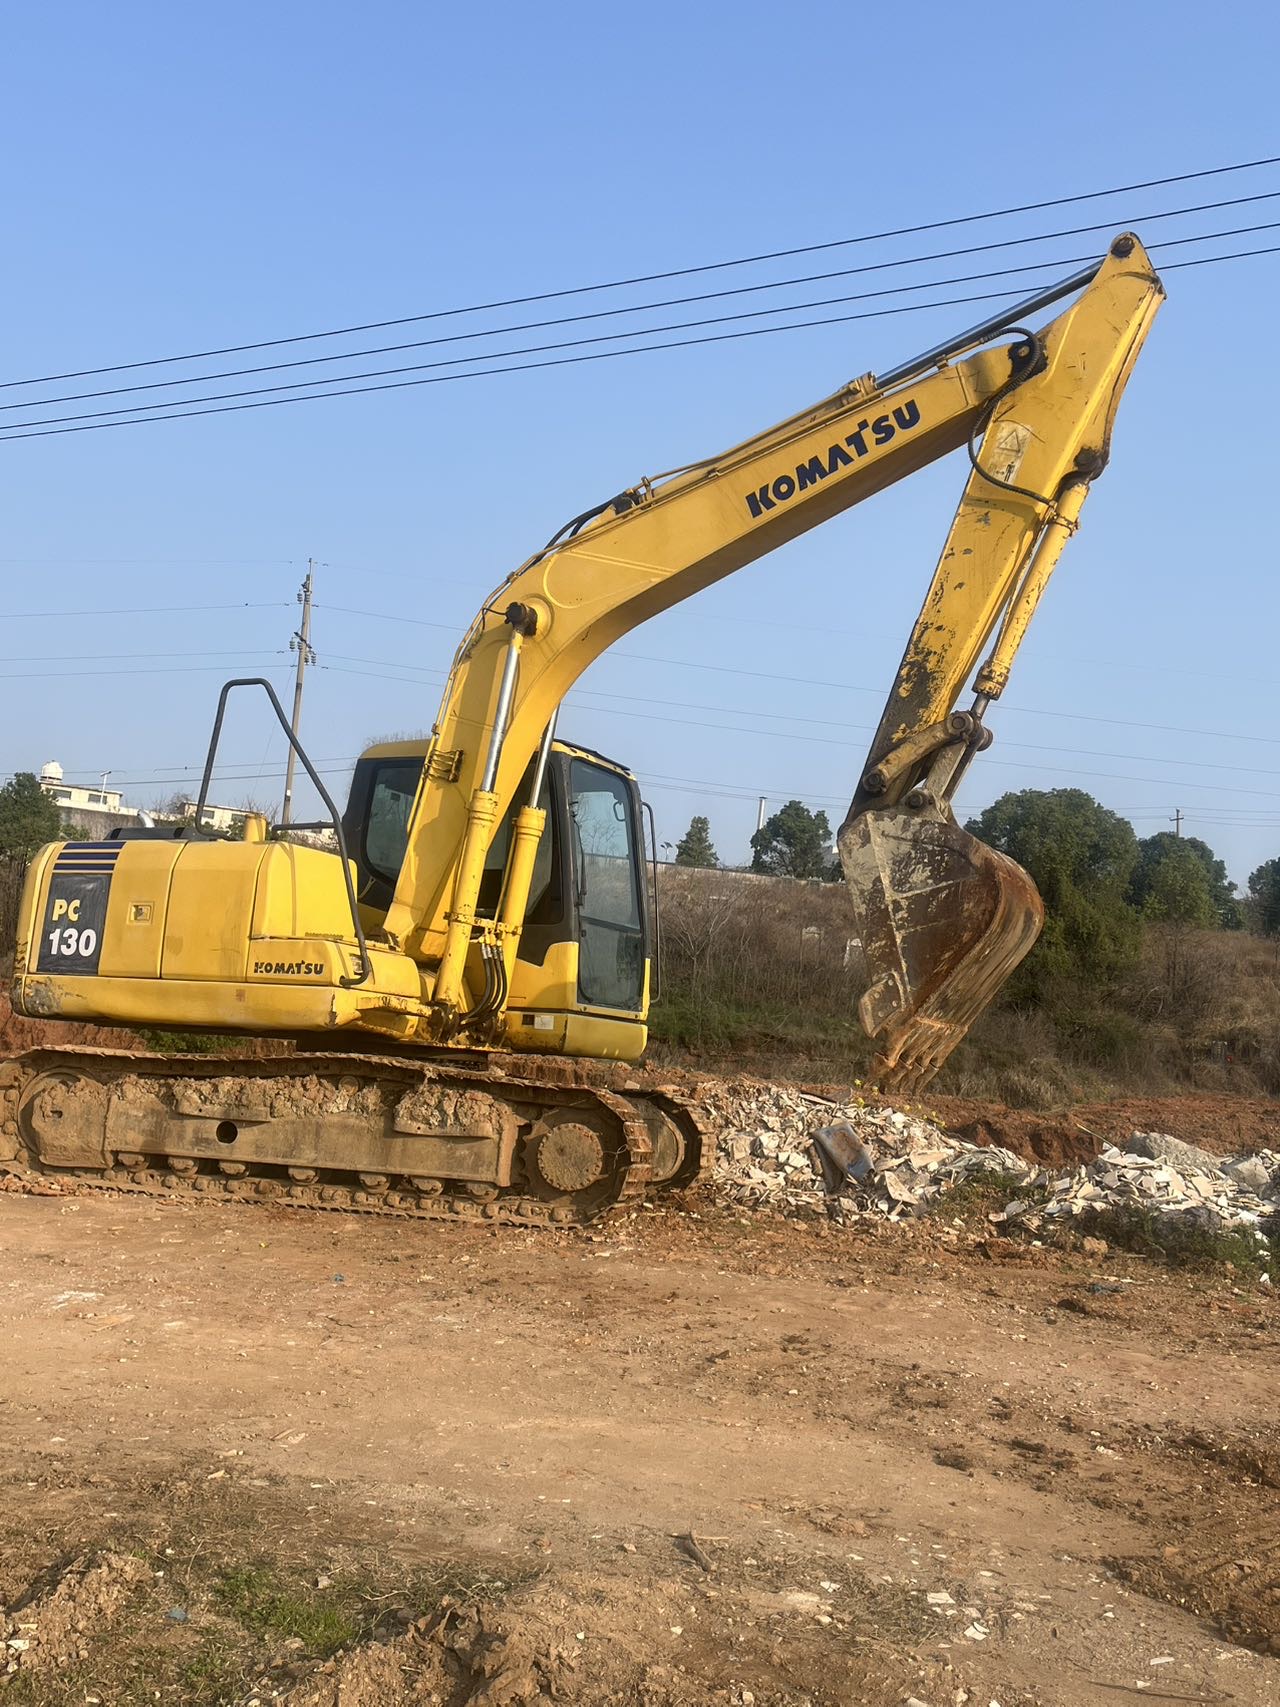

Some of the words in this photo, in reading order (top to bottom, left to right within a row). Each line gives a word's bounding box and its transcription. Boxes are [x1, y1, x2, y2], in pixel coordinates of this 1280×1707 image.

[745, 399, 921, 518] KOMATSU
[52, 899, 81, 921] PC
[49, 928, 97, 957] 130
[253, 960, 324, 975] KOMATSU
